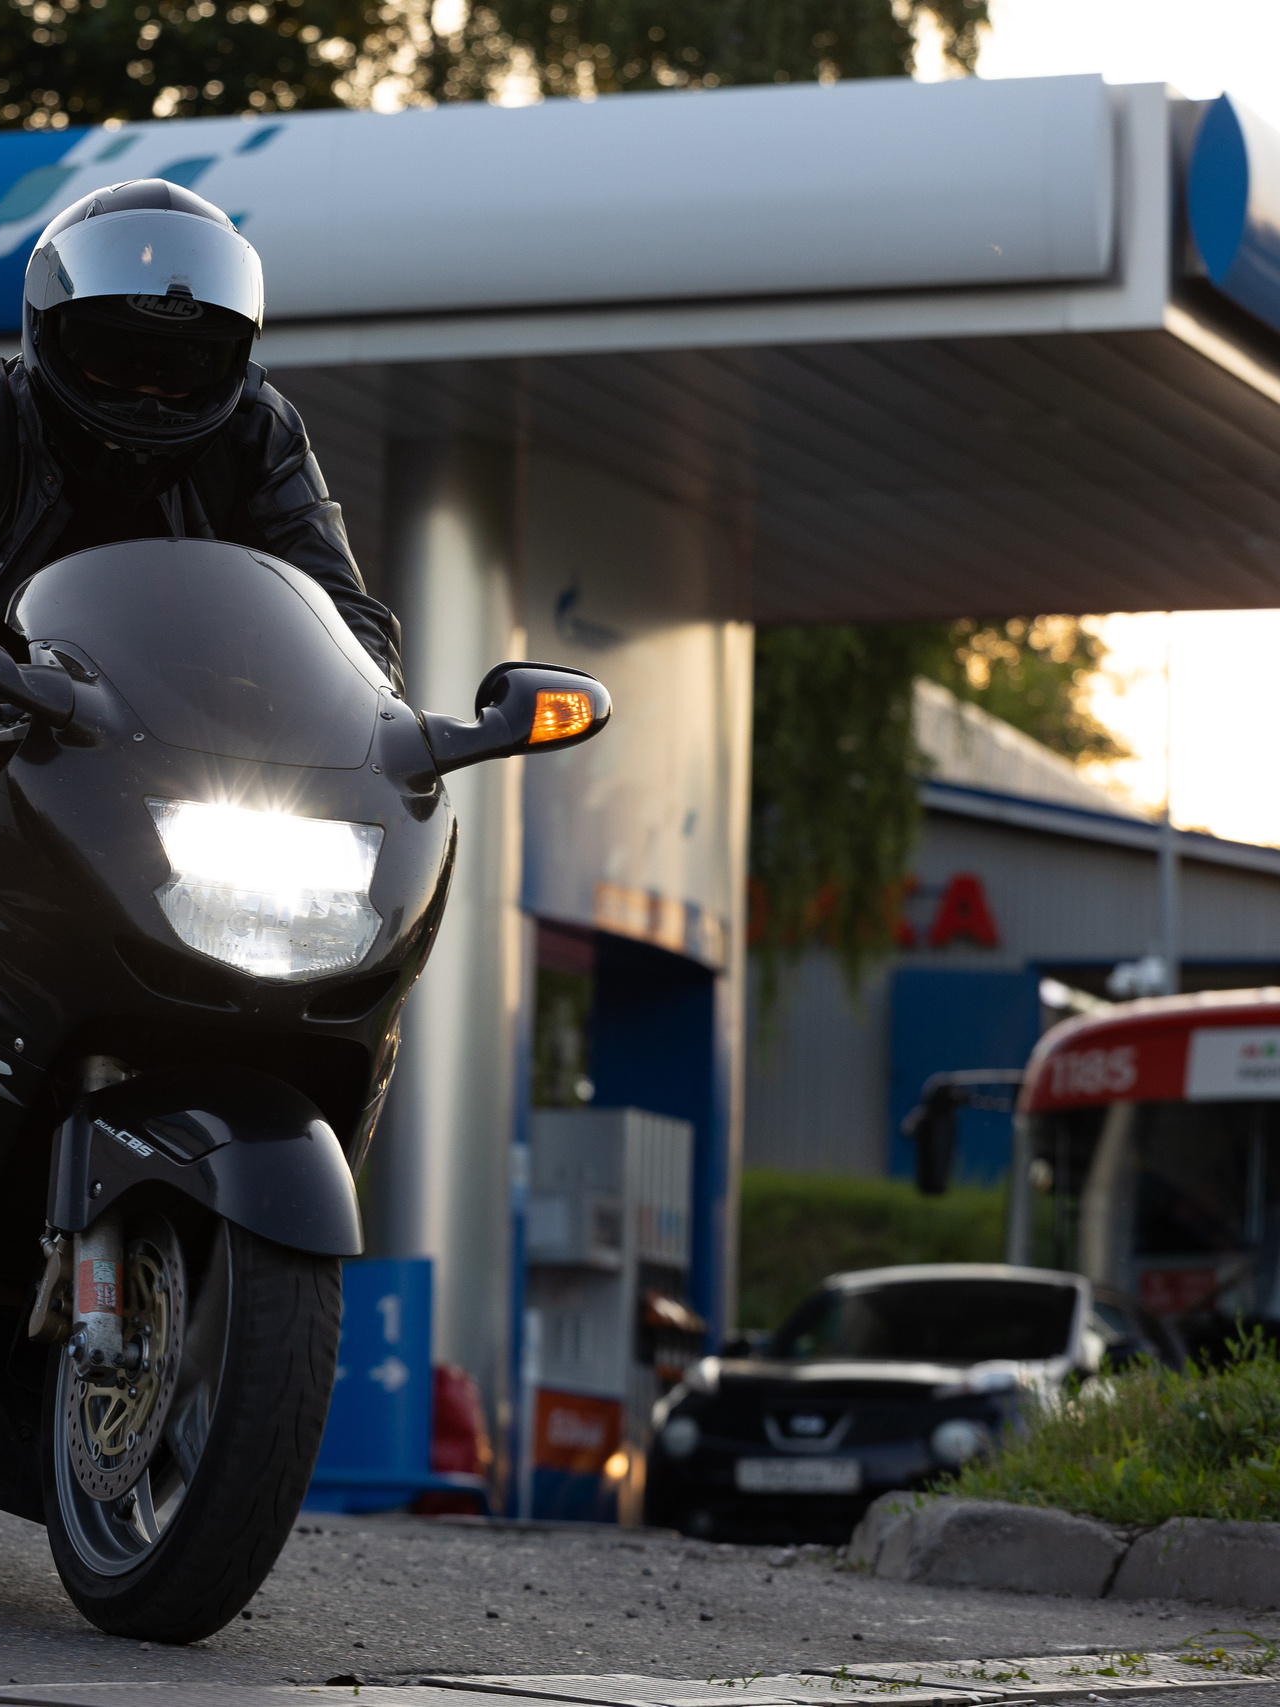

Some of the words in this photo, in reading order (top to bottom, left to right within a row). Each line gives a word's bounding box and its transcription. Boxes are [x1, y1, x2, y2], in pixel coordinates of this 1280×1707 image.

[136, 295, 194, 316] HJC
[1051, 1046, 1138, 1098] 1185
[94, 1118, 116, 1136] DUAL
[115, 1130, 154, 1157] CBS
